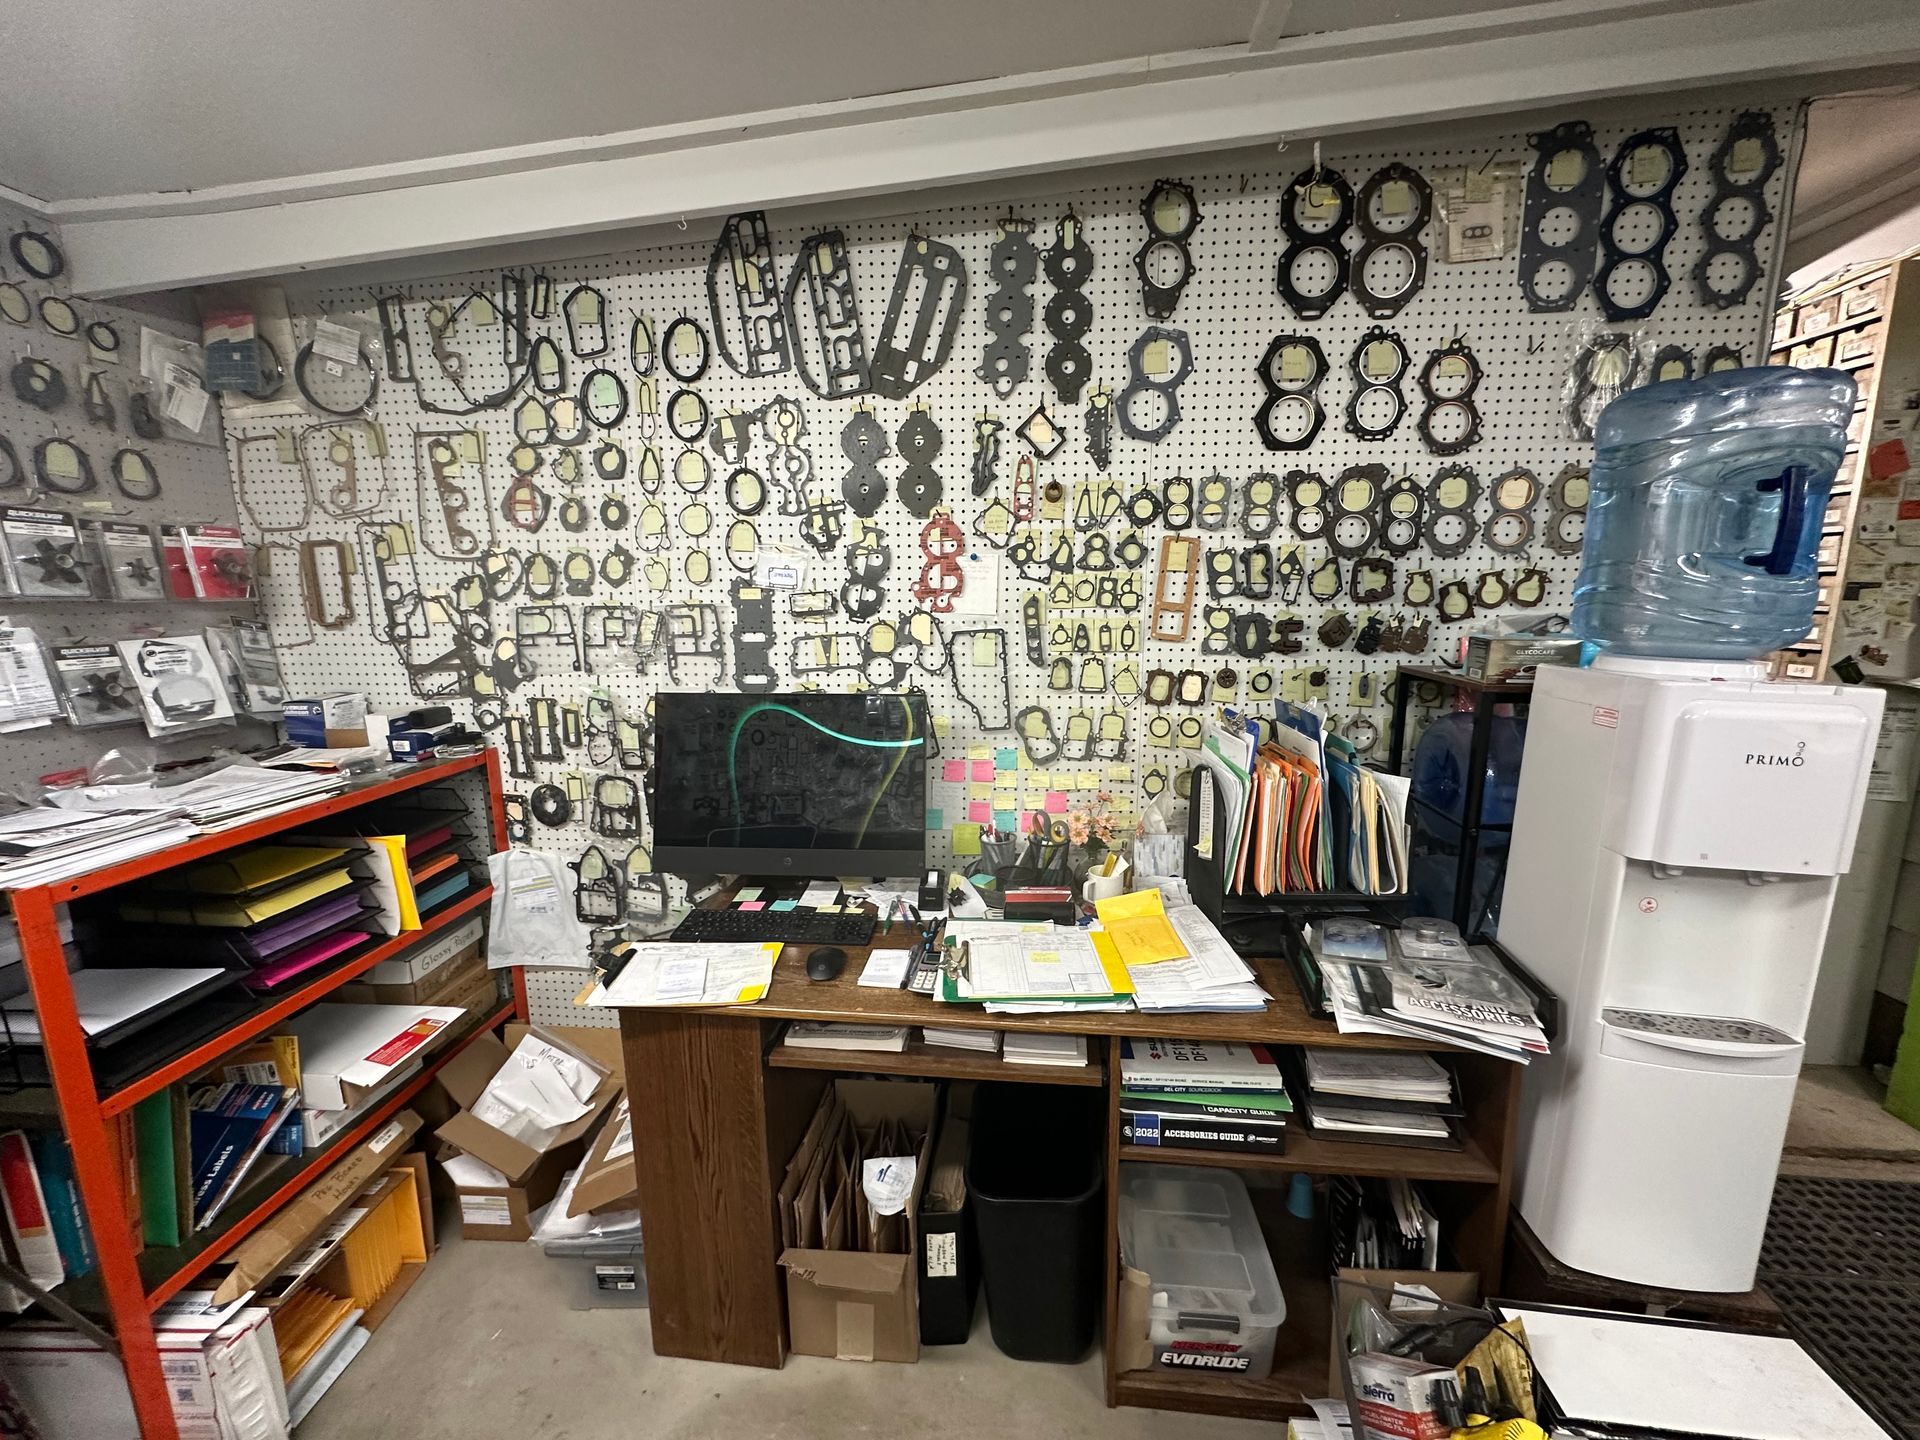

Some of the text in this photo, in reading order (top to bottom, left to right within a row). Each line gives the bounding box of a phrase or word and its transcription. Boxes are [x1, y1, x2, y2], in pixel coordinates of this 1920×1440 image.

[1745, 753, 1805, 768] PRIMO
[1408, 996, 1527, 1027] ACCESSORIES
[1206, 1105, 1277, 1117] CAPACITY GUIDE
[1134, 1127, 1160, 1138] 2022
[1163, 1129, 1219, 1141] ACCESSORIES
[1219, 1132, 1246, 1142] GUIDE
[206, 1144, 235, 1179] Labels
[1160, 1351, 1250, 1370] EVINRUDE
[1362, 1383, 1396, 1403] sierra
